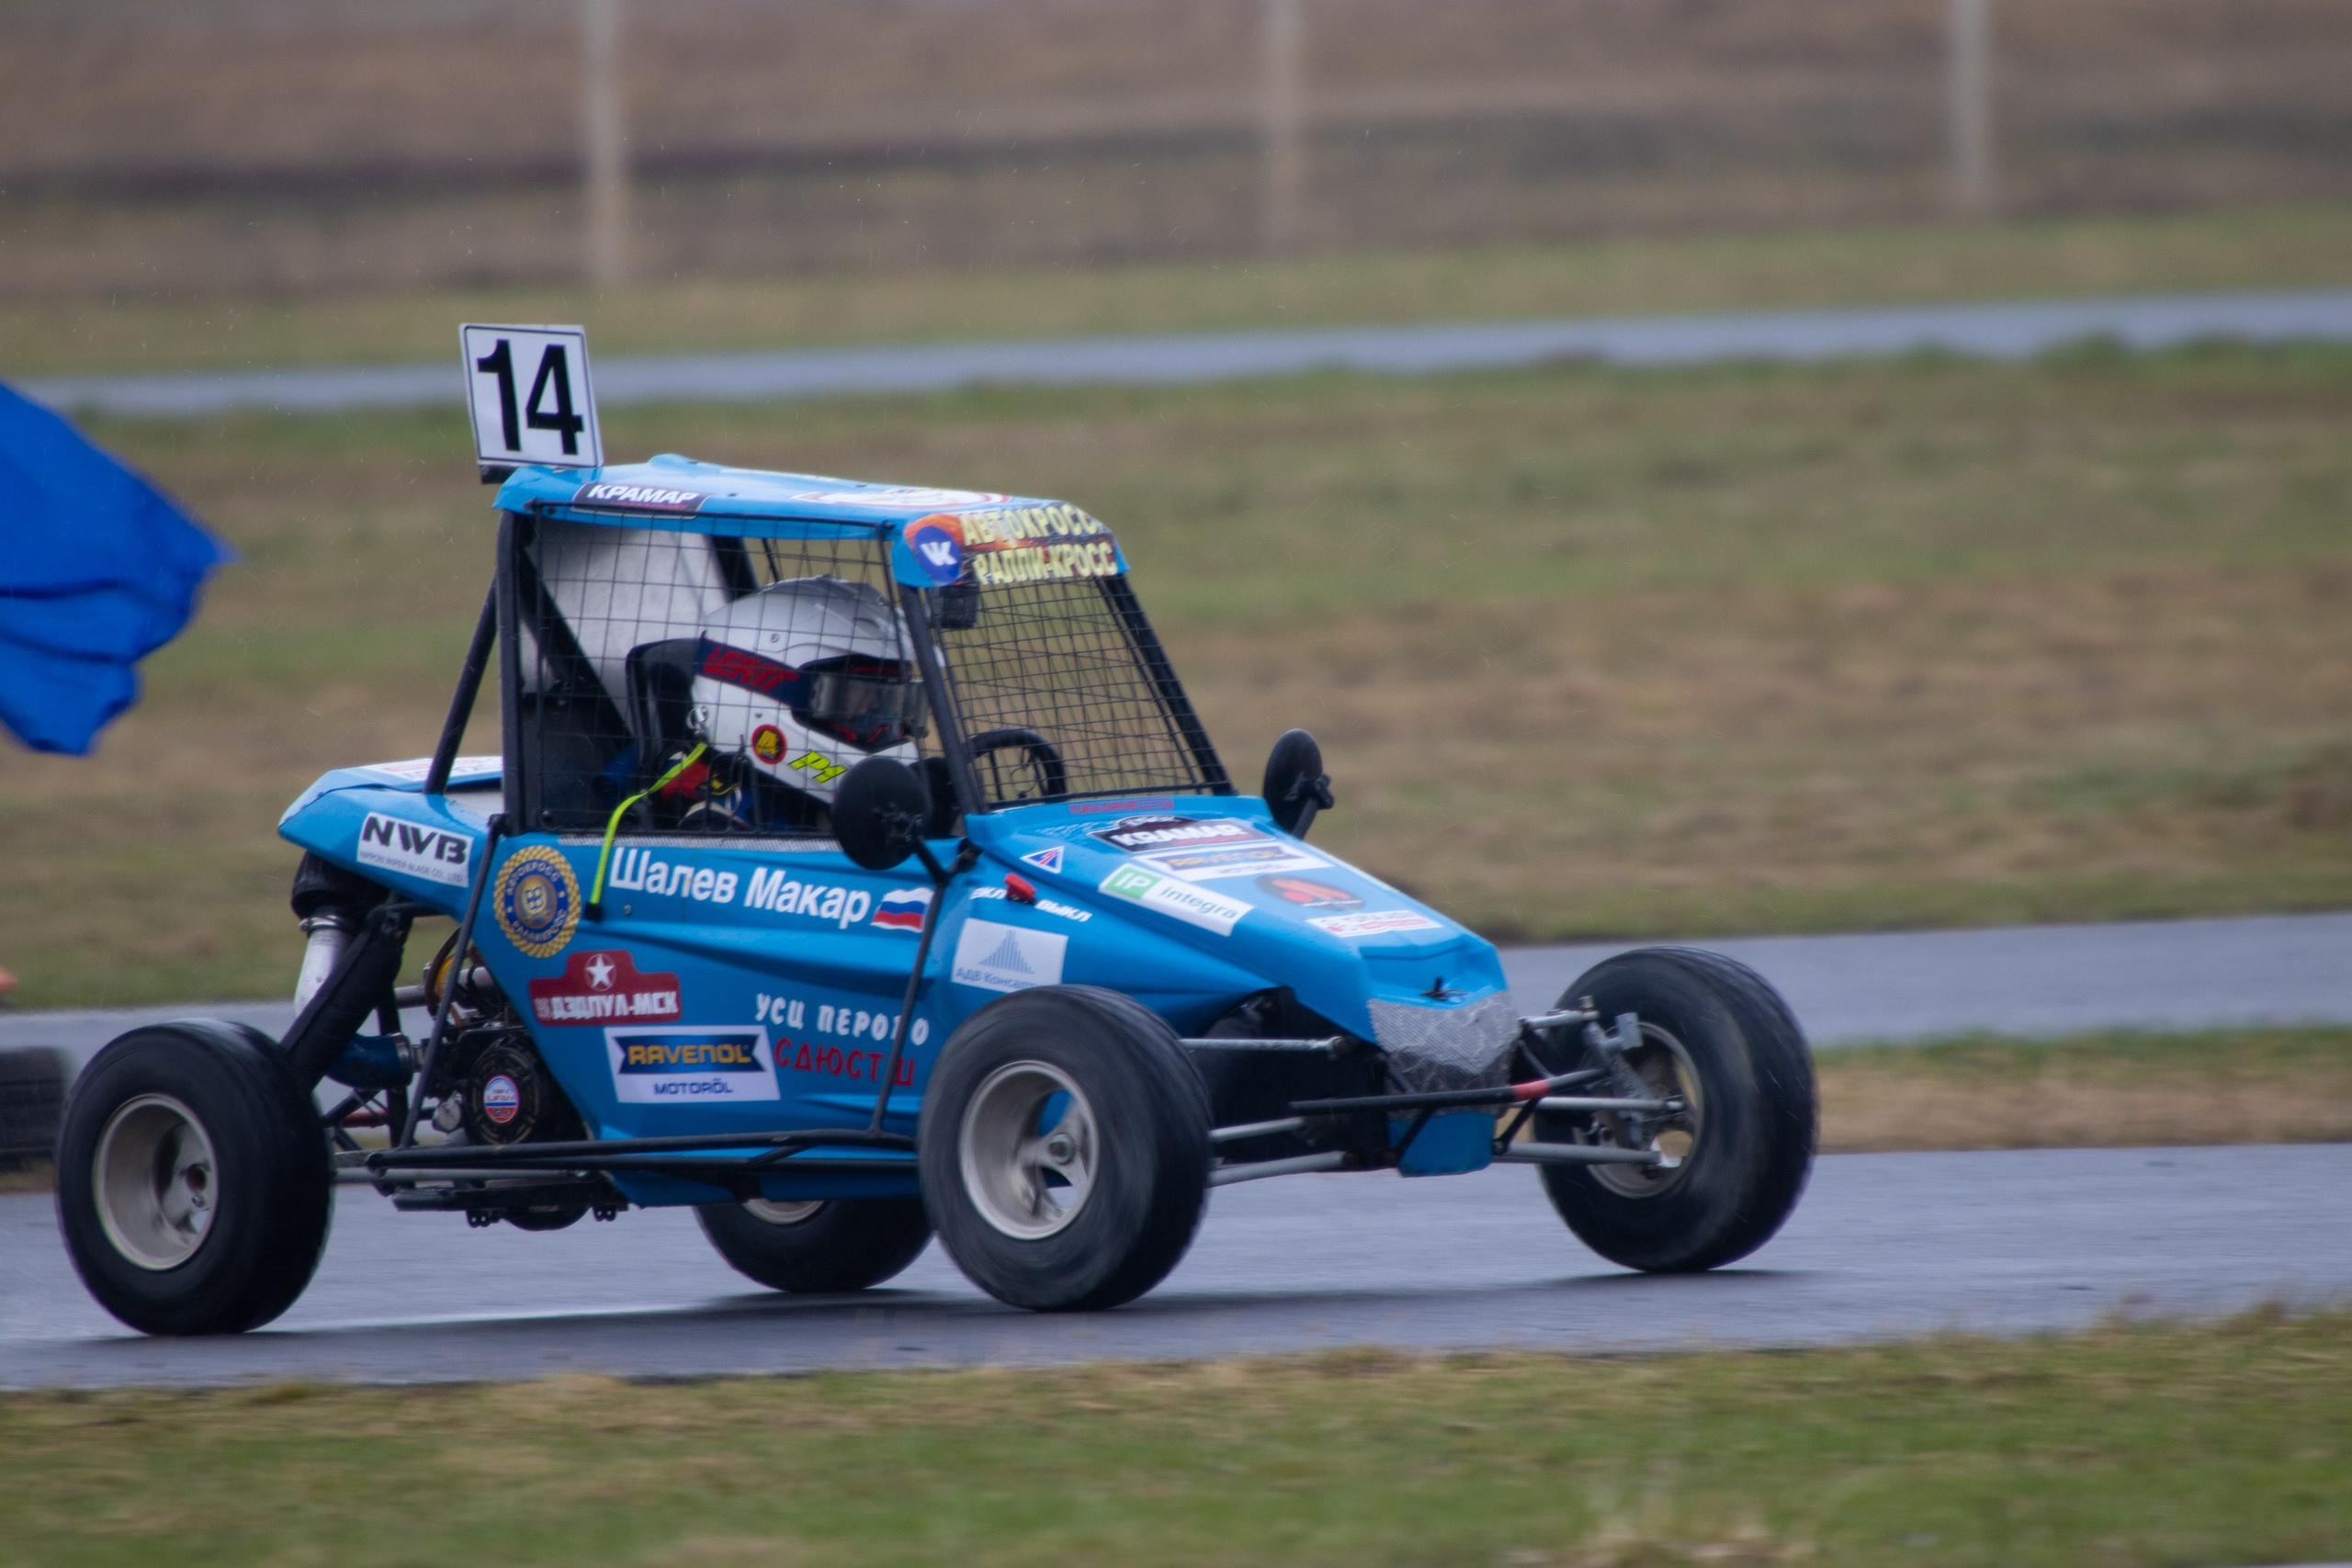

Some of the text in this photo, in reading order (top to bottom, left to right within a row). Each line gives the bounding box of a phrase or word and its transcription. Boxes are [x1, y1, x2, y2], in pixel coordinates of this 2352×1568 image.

[476, 338, 584, 456] 14
[586, 484, 700, 504] КРАМАР
[960, 504, 1100, 547] АВТОКРОСС
[362, 816, 468, 865] NWB
[608, 847, 871, 930] Шалев Макар
[755, 992, 805, 1031] УСЦ
[628, 1043, 752, 1066] RAVENOL
